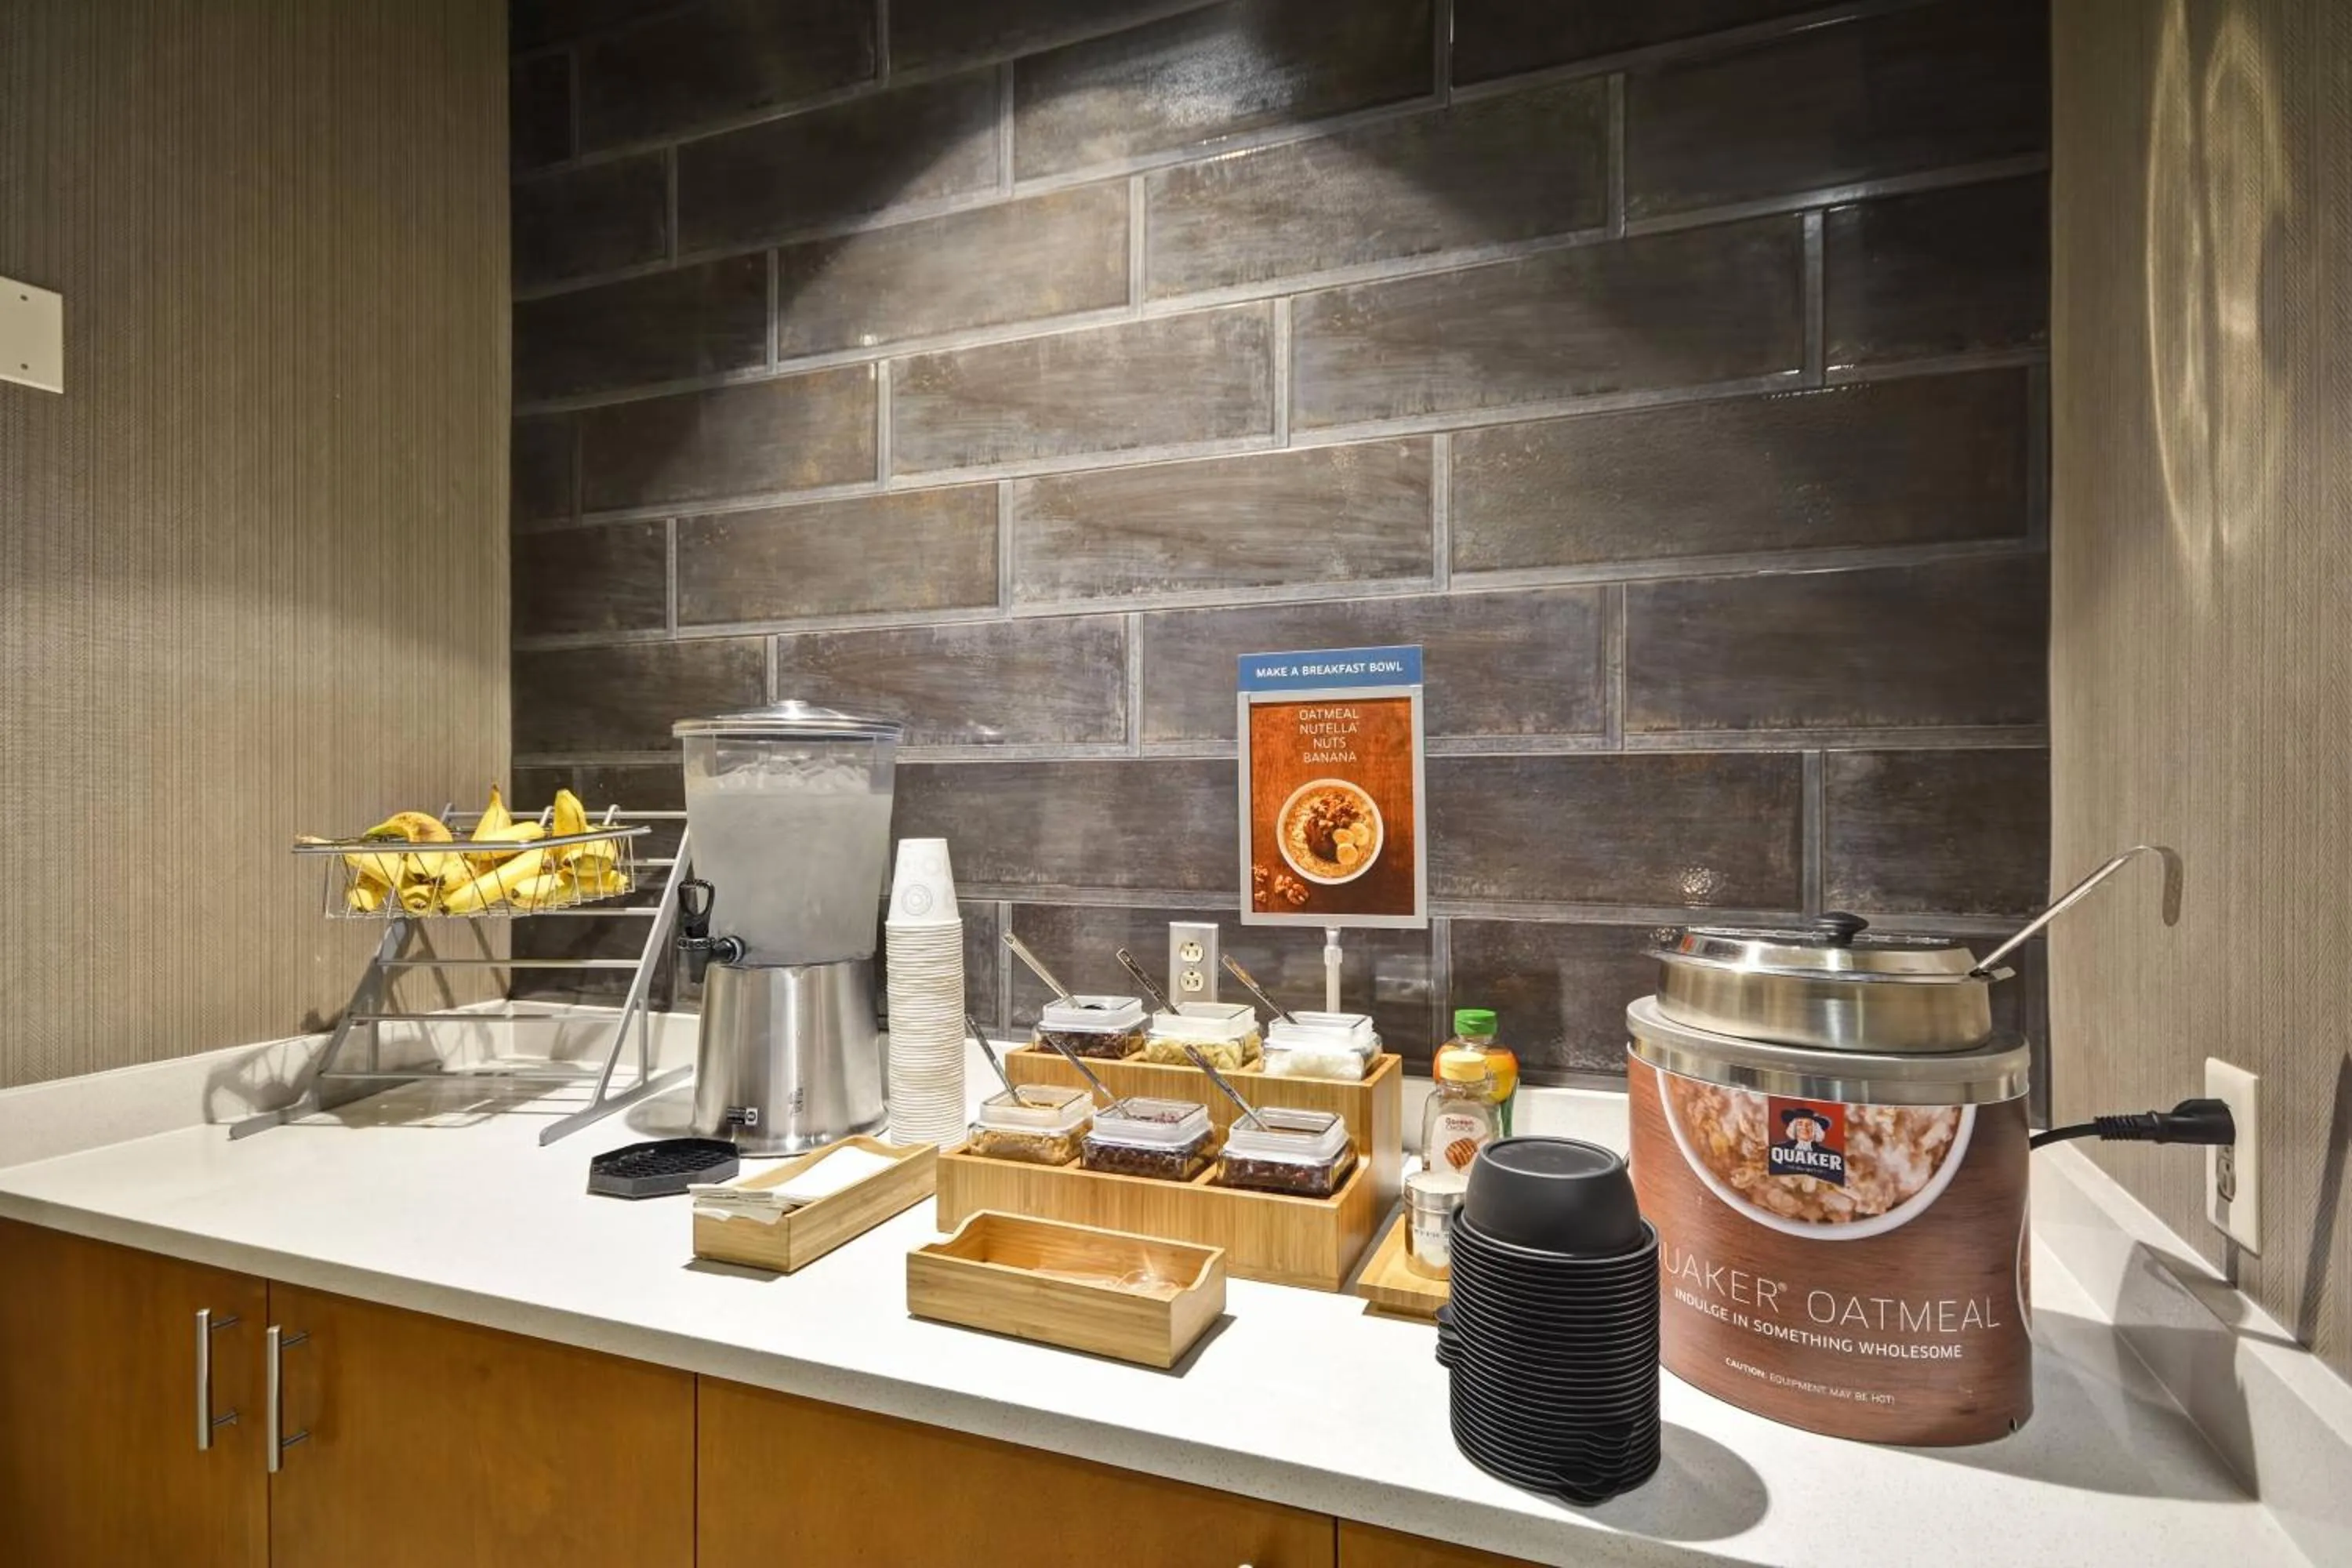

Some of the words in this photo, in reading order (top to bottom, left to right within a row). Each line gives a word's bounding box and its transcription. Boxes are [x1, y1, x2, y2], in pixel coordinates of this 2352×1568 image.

[1256, 666, 1287, 678] MAKE
[1290, 666, 1299, 677] A
[1302, 662, 1365, 676] BREAKFAST
[1370, 661, 1403, 673] BOWL
[1298, 708, 1359, 720] OATMEAL
[1313, 737, 1346, 750] NUTS
[1304, 751, 1357, 764] BANANA
[1771, 1147, 1842, 1171] QUAKER
[1658, 1241, 1780, 1315] UAKER
[1807, 1290, 2002, 1333] OATMEAL
[1675, 1287, 1729, 1321] INDULGE
[1733, 1312, 1749, 1328] IN
[1753, 1319, 1853, 1352] SOMETHING
[1859, 1341, 1963, 1359] WHOLESOME
[1769, 1373, 1827, 1394] EQUIPMENT
[1829, 1388, 1852, 1399] MAY
[1853, 1392, 1867, 1402] BE
